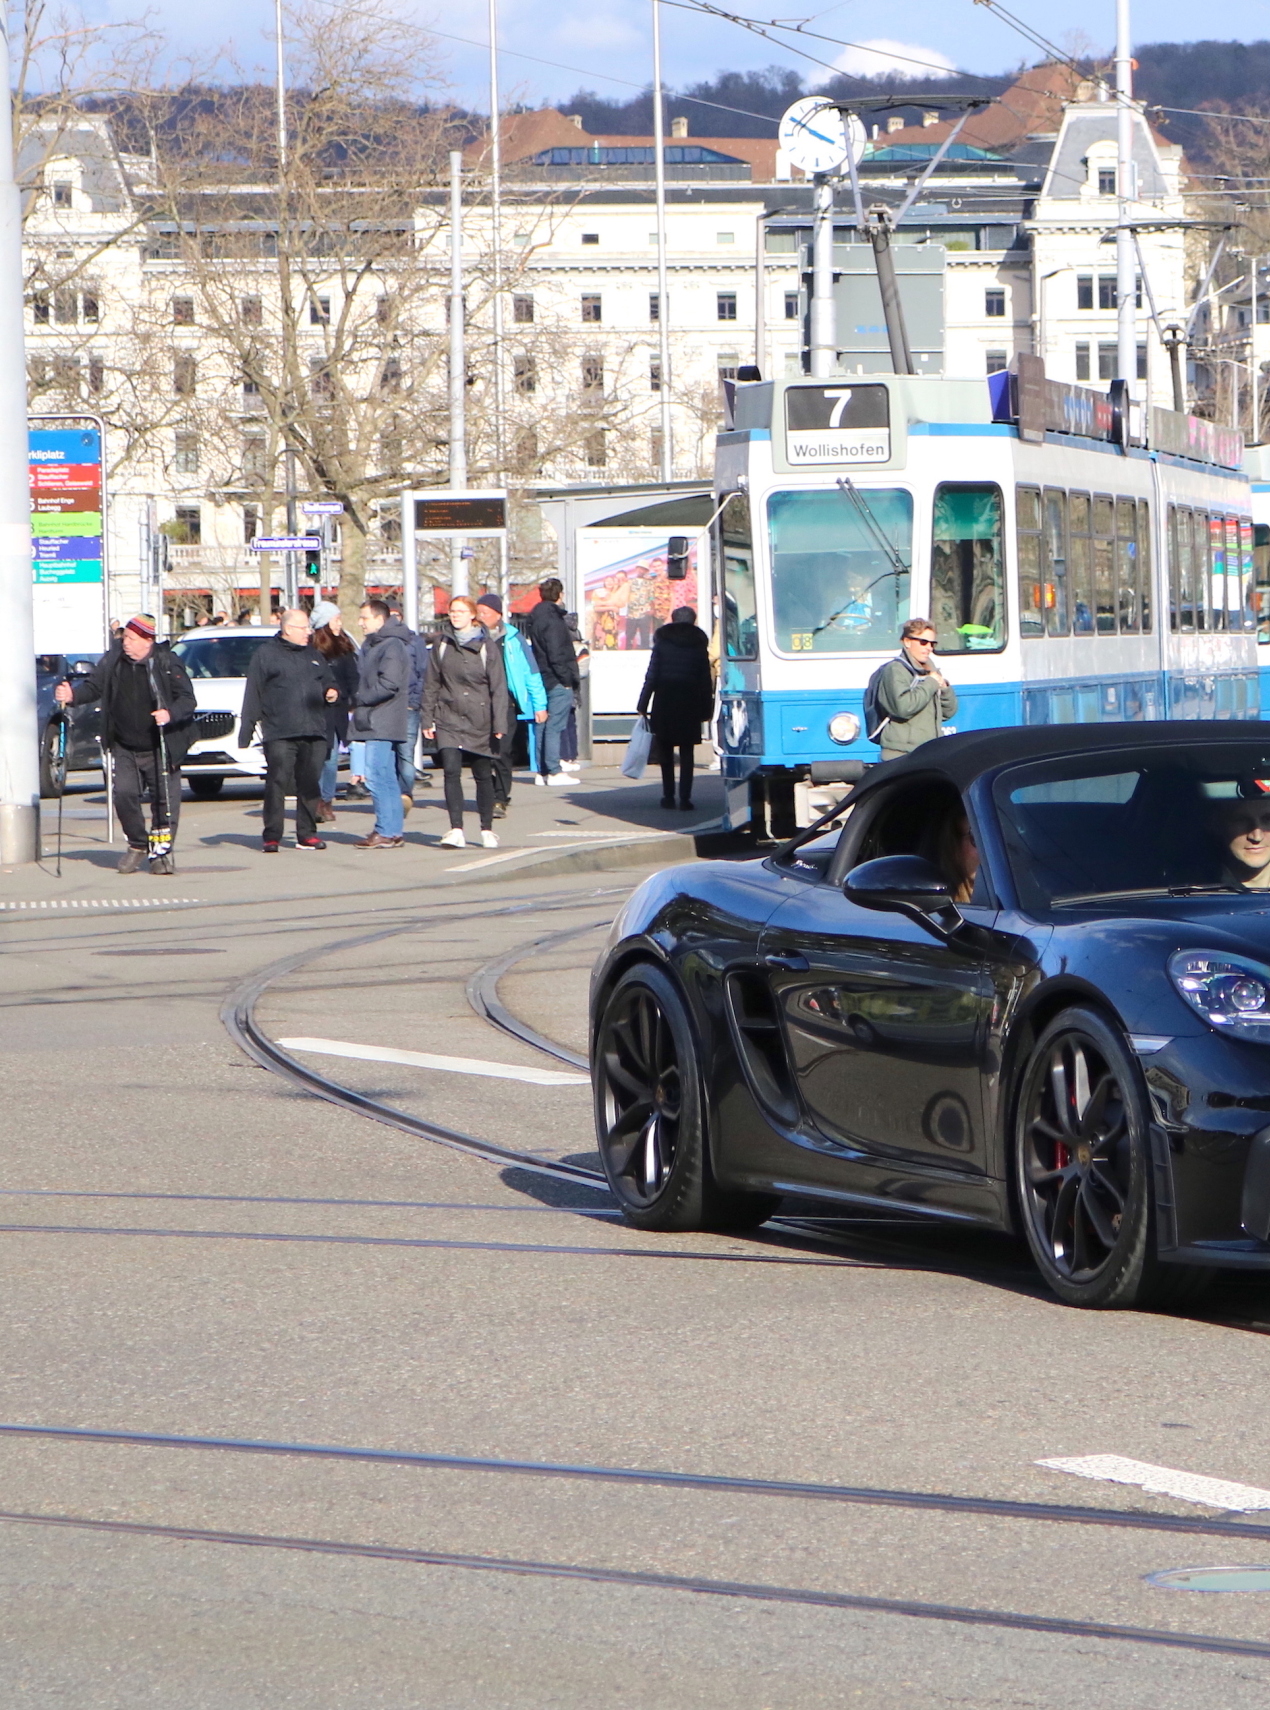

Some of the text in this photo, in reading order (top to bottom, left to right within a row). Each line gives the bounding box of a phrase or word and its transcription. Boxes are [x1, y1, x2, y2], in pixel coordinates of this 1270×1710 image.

[824, 389, 852, 428] 7
[28, 450, 65, 461] rkliplatz
[793, 443, 885, 458] Wollishofen
